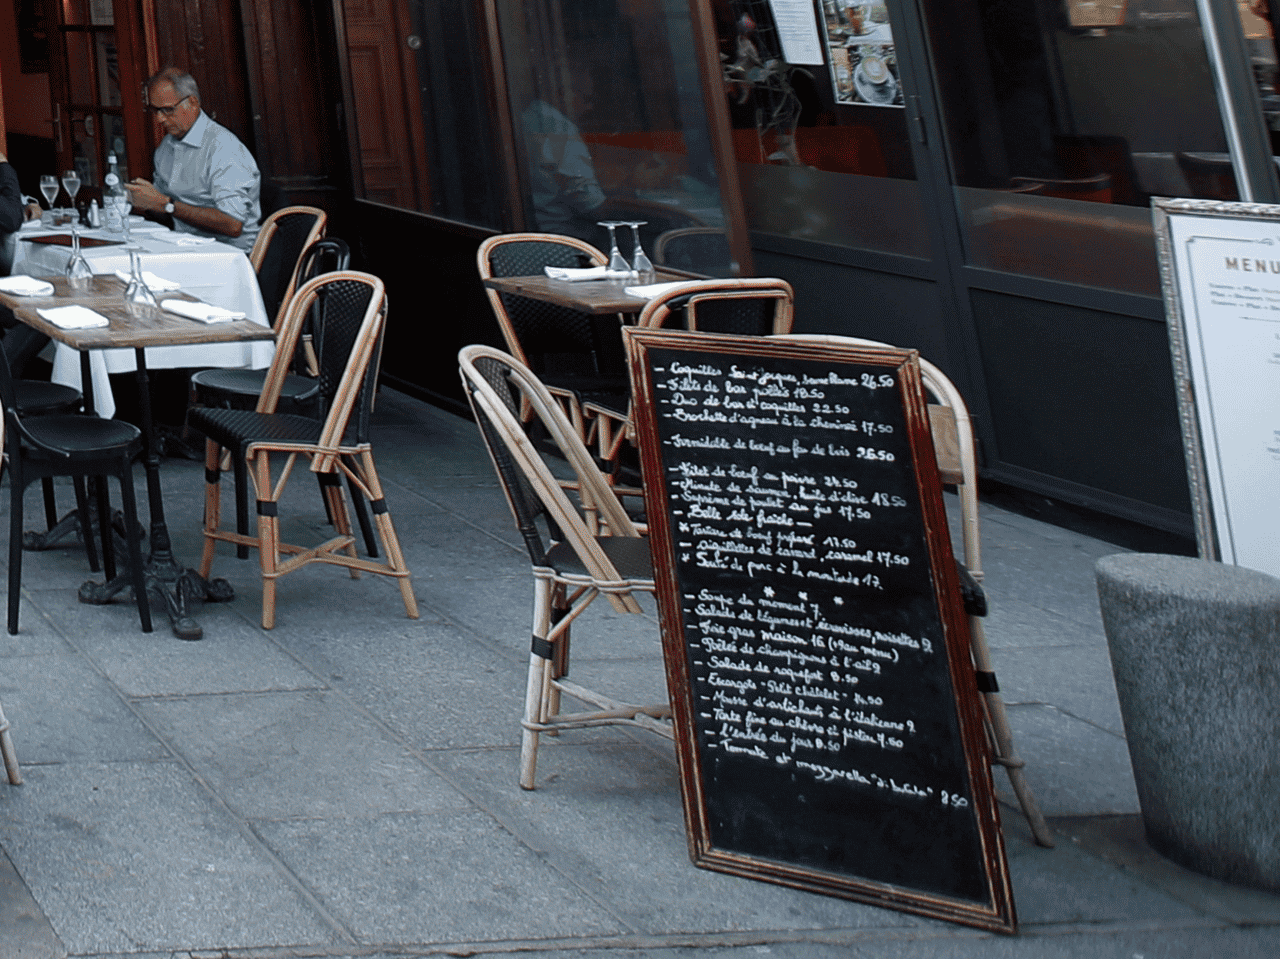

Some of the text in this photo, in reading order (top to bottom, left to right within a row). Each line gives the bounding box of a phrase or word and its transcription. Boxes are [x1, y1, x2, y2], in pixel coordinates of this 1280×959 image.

[670, 361, 722, 382] Coquilles
[861, 373, 895, 390] 26.50
[671, 392, 698, 406] Duo
[703, 394, 721, 407] de
[861, 421, 894, 437] 17.50
[877, 551, 910, 568] 17.50
[698, 588, 735, 611] Soupe
[727, 626, 756, 640] gras
[760, 630, 808, 646] maison
[707, 655, 752, 672] Salade
[753, 661, 771, 673] de
